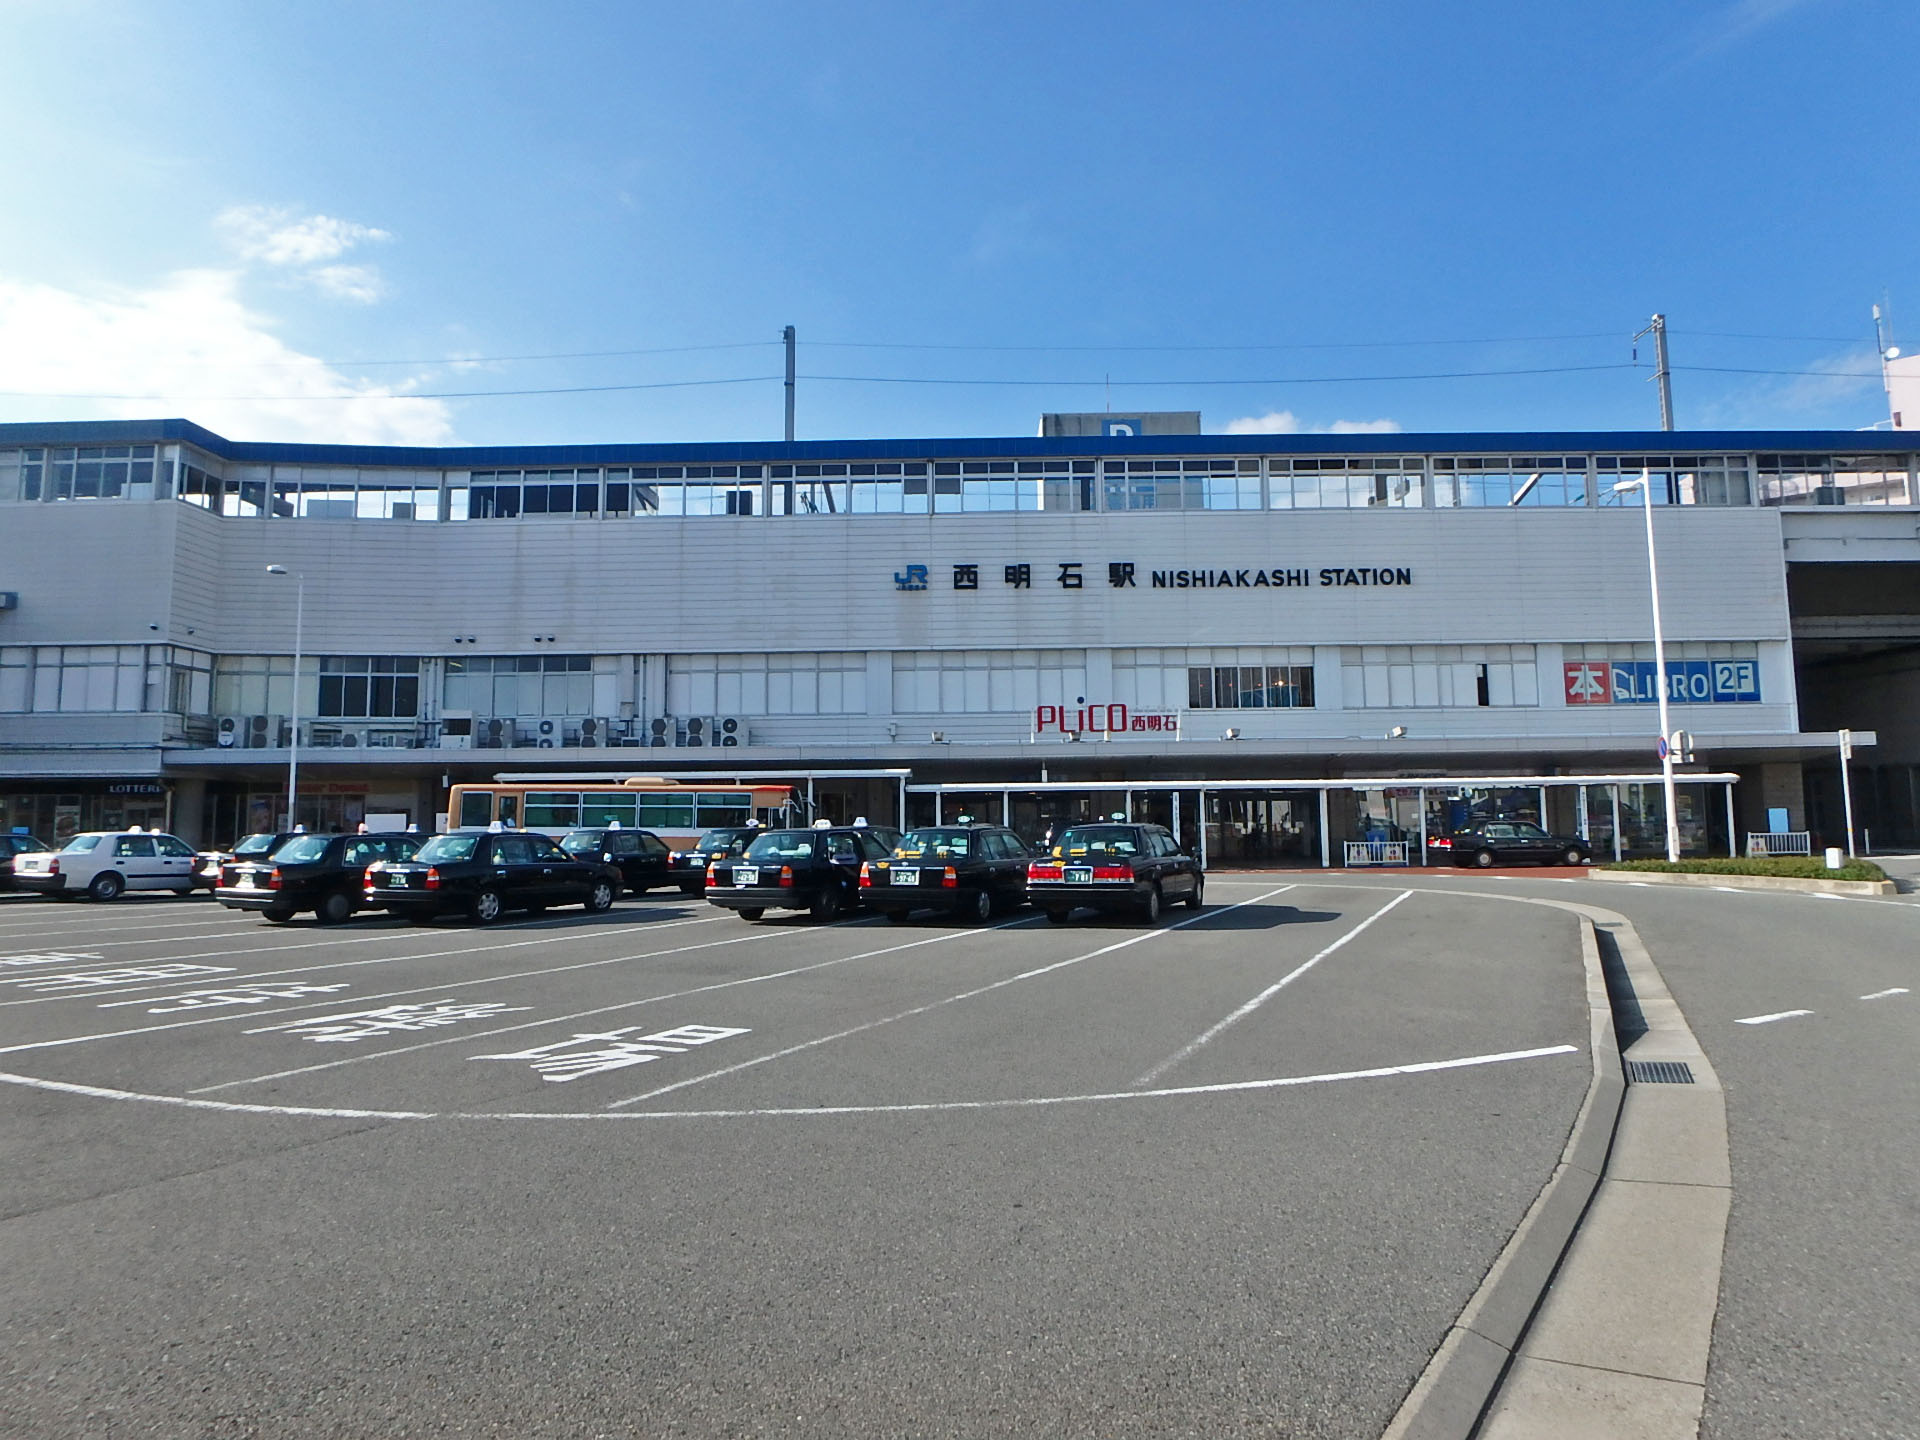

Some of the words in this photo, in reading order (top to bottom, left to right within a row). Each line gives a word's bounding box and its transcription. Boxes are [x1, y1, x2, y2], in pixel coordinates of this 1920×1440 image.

[894, 564, 929, 584] JR
[953, 562, 1136, 590] 西明石駅
[1152, 569, 1310, 588] NISHIAKASHI
[1319, 568, 1412, 586] STATION
[1567, 664, 1605, 700] 本
[1629, 673, 1709, 699] LIBRO
[1719, 666, 1749, 690] 2F
[1131, 715, 1178, 732] 西明石
[109, 784, 162, 793] LOTTERI
